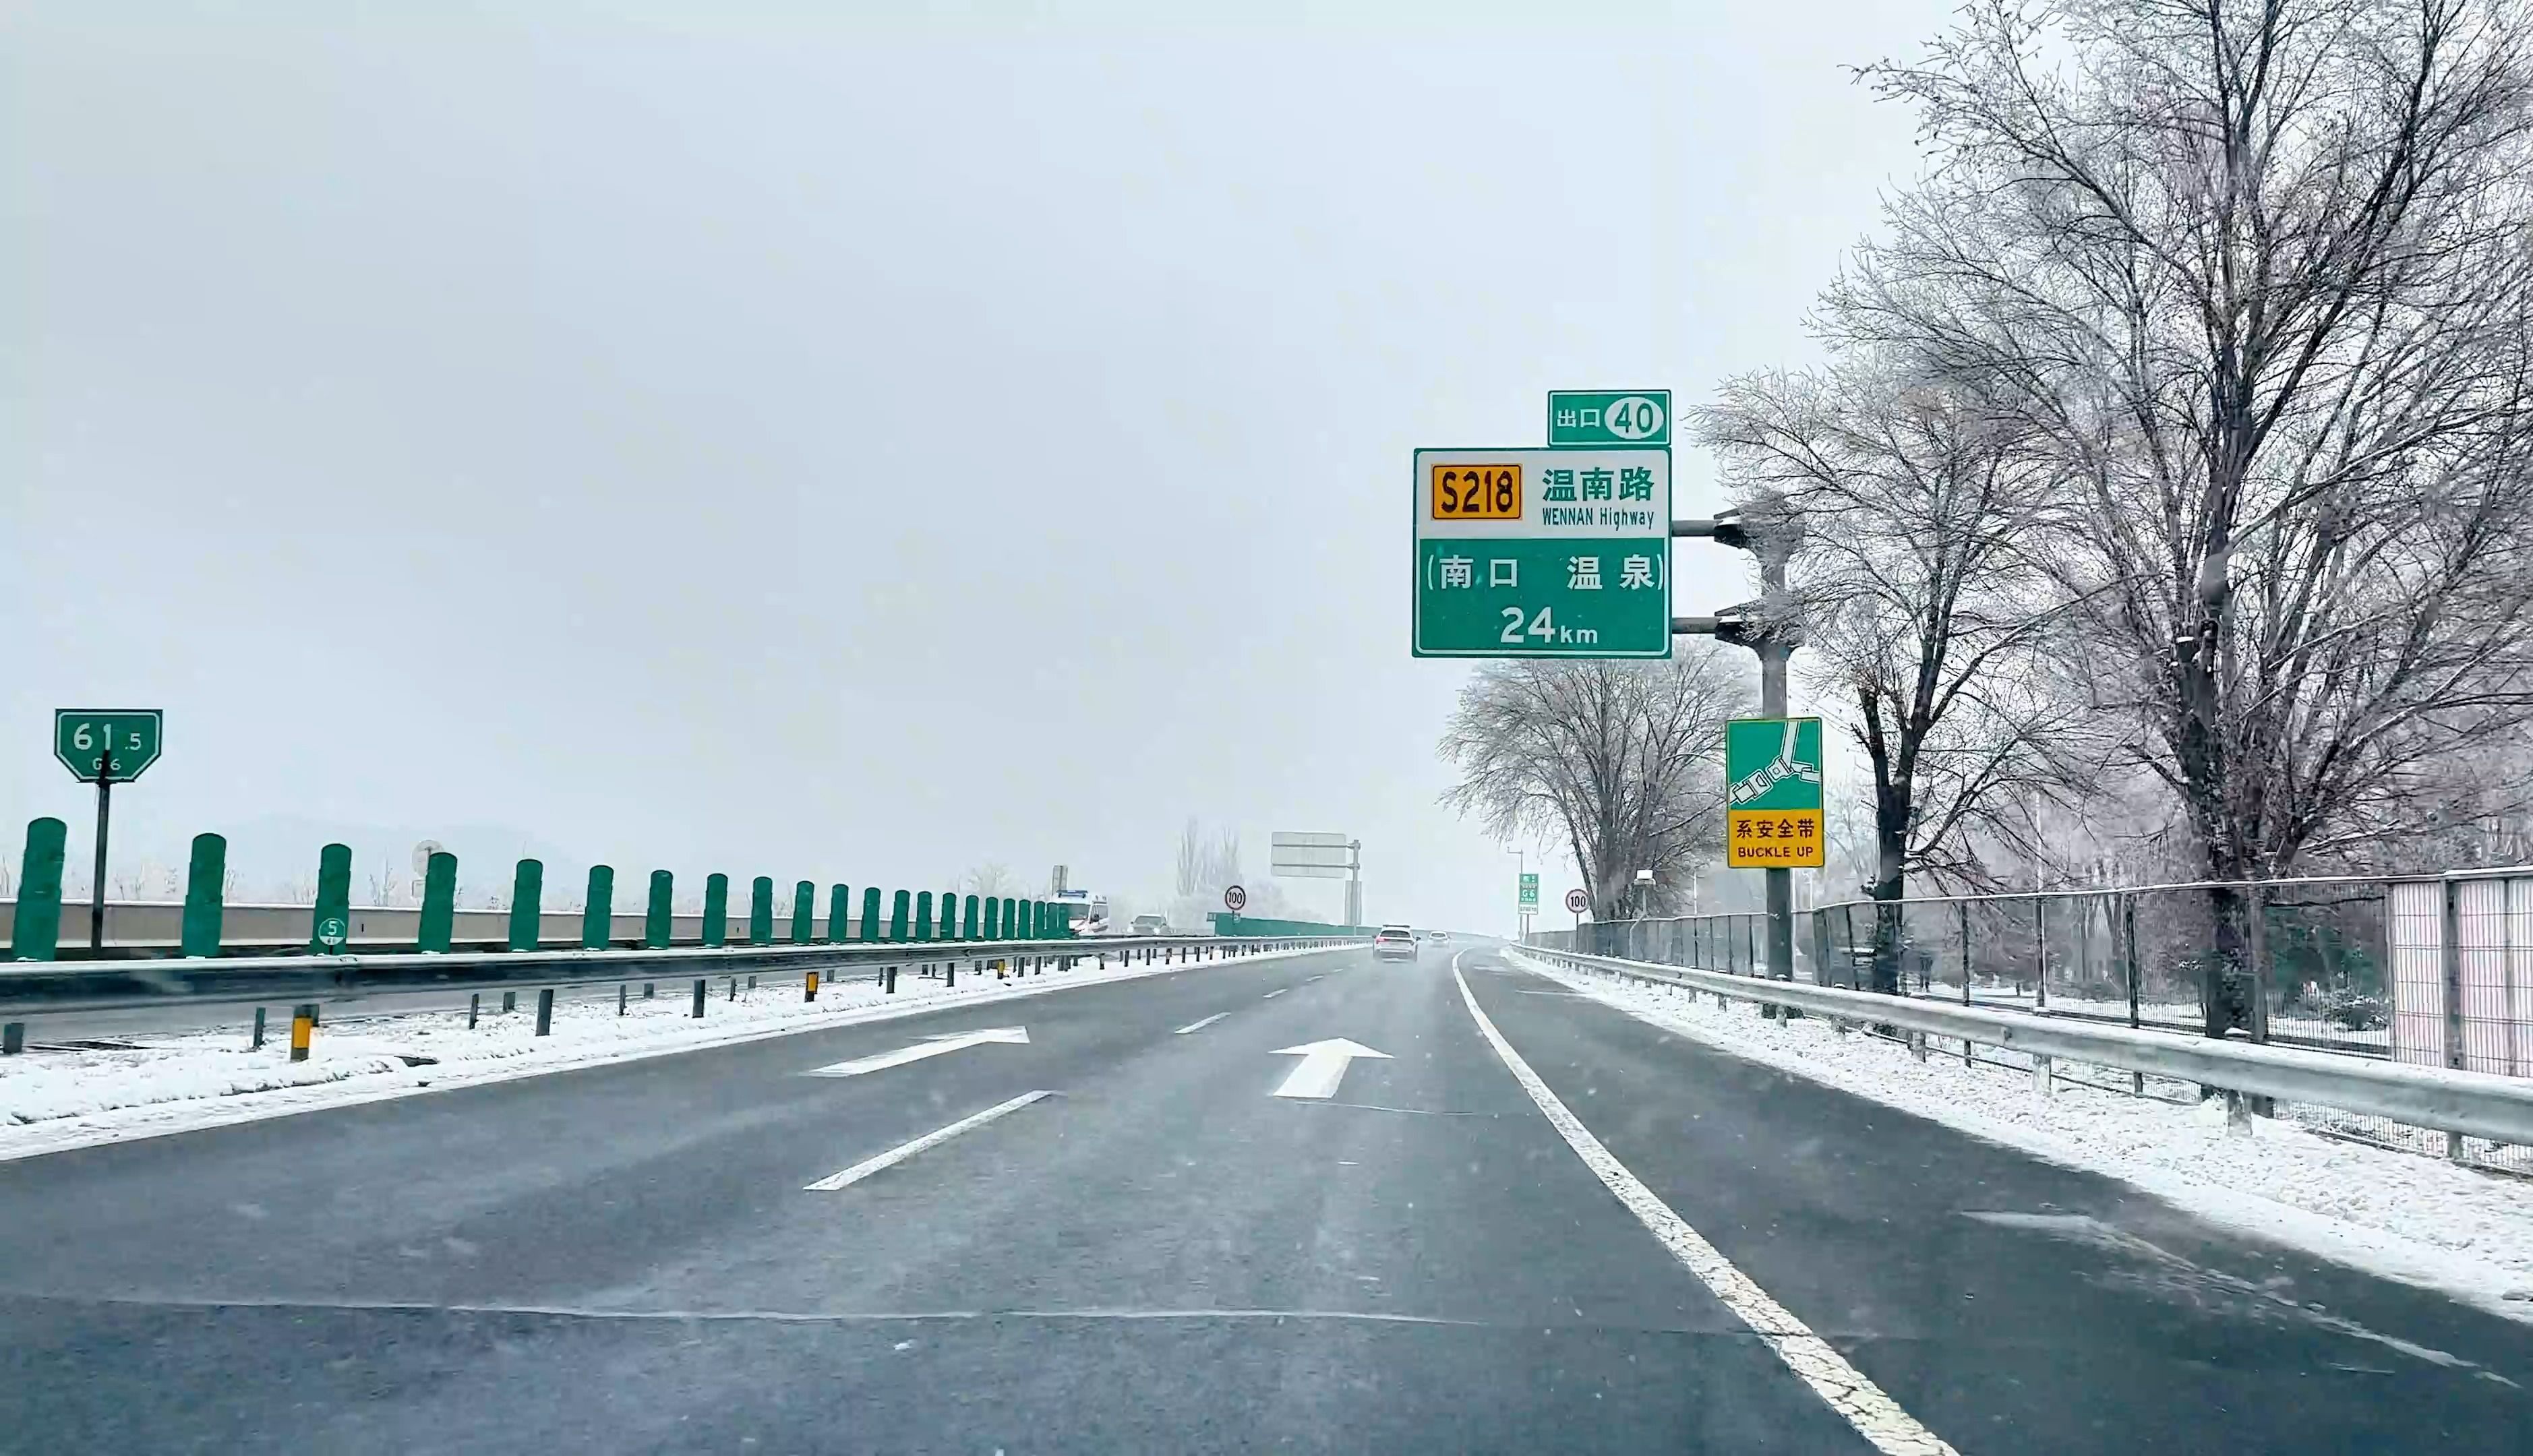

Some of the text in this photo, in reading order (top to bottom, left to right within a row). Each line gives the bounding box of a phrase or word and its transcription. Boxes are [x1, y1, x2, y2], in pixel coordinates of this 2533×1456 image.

[1557, 402, 1653, 433] 出口 40
[1441, 471, 1514, 513] S218
[1542, 466, 1655, 502] 温南路
[1543, 508, 1654, 530] WENNAN Highway
[1736, 818, 1815, 839] 系安全带
[1738, 846, 1814, 857] BUCKLE UP
[1228, 892, 1243, 904] 100
[1570, 895, 1586, 907] 100
[328, 920, 338, 936] 5
